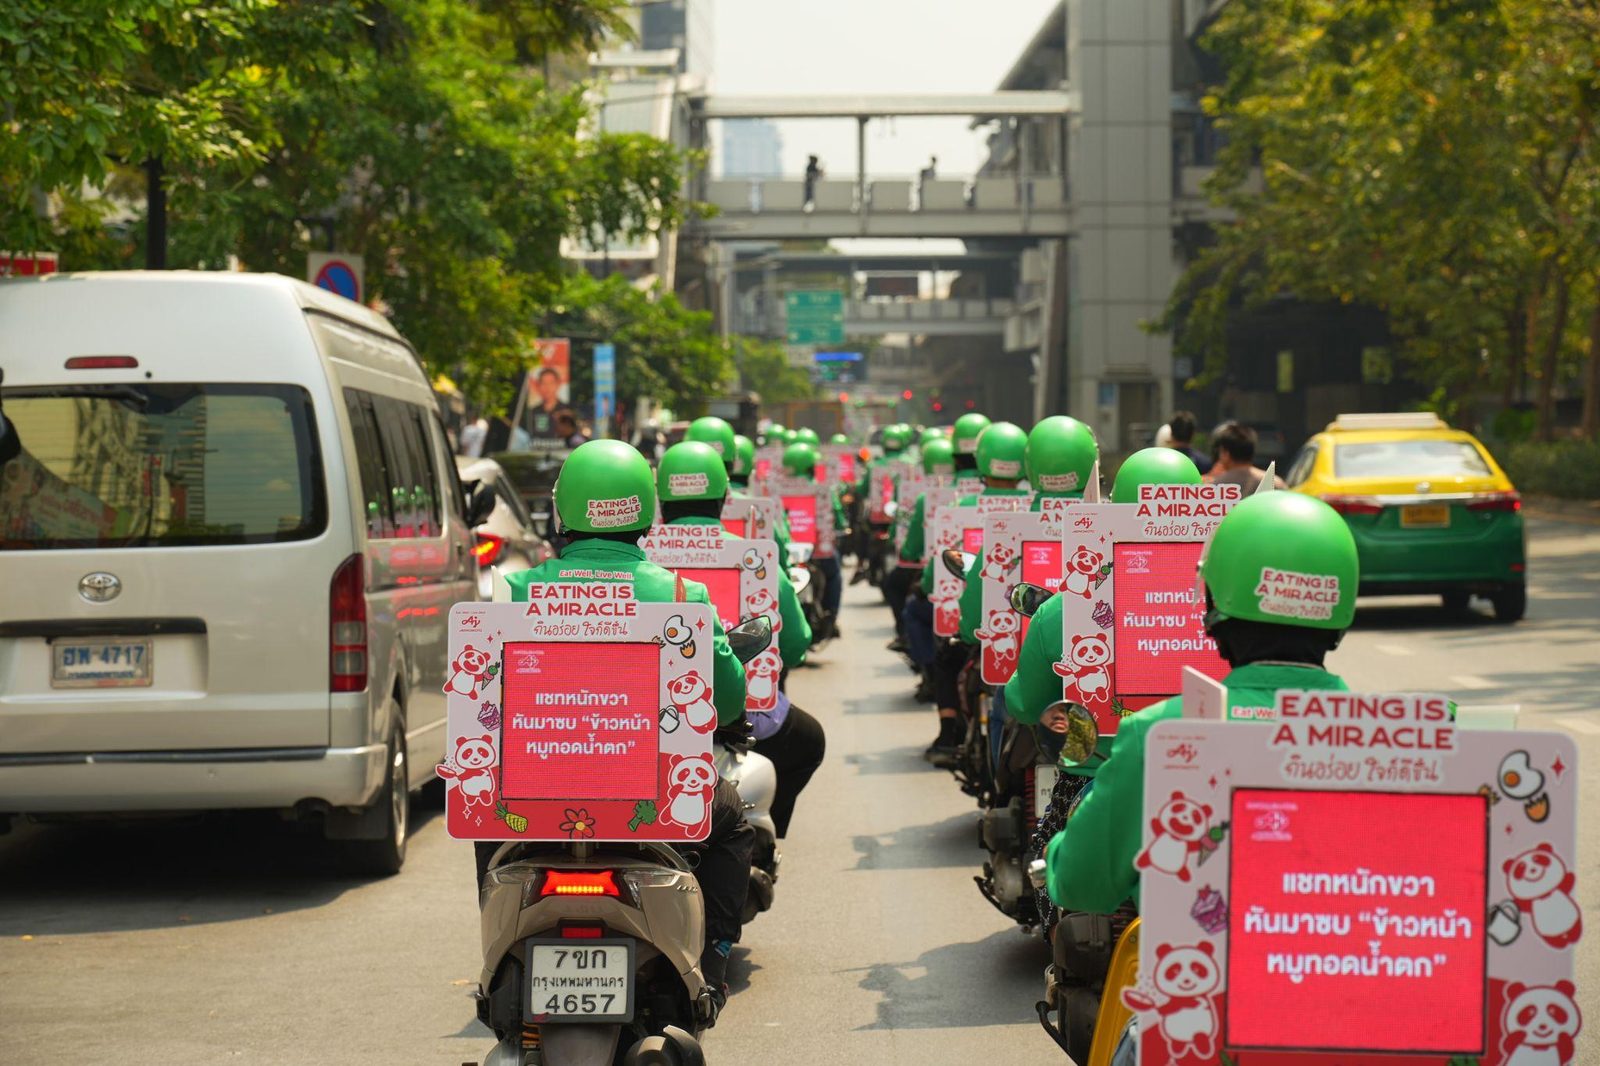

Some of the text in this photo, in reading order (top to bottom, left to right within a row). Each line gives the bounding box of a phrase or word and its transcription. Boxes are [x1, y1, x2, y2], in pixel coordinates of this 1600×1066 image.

[1141, 486, 1239, 500] EATING IS
[587, 504, 641, 517] A MIRACLE
[589, 496, 638, 509] EATING IS
[1137, 503, 1151, 517] A
[1040, 513, 1050, 522] A
[647, 527, 720, 537] EATING IS
[645, 540, 724, 549] A MIRACLE
[1263, 570, 1337, 589] EATING IS
[531, 585, 632, 599] EATING IS
[1257, 583, 1338, 603] A MIRACLE
[526, 602, 637, 616] A MIRACLE
[534, 620, 580, 636] กินอร่อย
[1123, 611, 1186, 628] หันมาซบ
[100, 645, 145, 665] 4717
[535, 688, 628, 706] แชทหนักขวา
[1281, 695, 1445, 721] EATING IS
[512, 713, 577, 730] หันมาซบ
[1273, 724, 1453, 750] A MIRACLE
[1282, 867, 1435, 897] แชทหนักขวา
[1244, 904, 1351, 935] หันมาซบ
[554, 949, 607, 969] 7ขก
[533, 976, 624, 991] กรุงเทพมหานคร
[545, 994, 615, 1013] 4657
